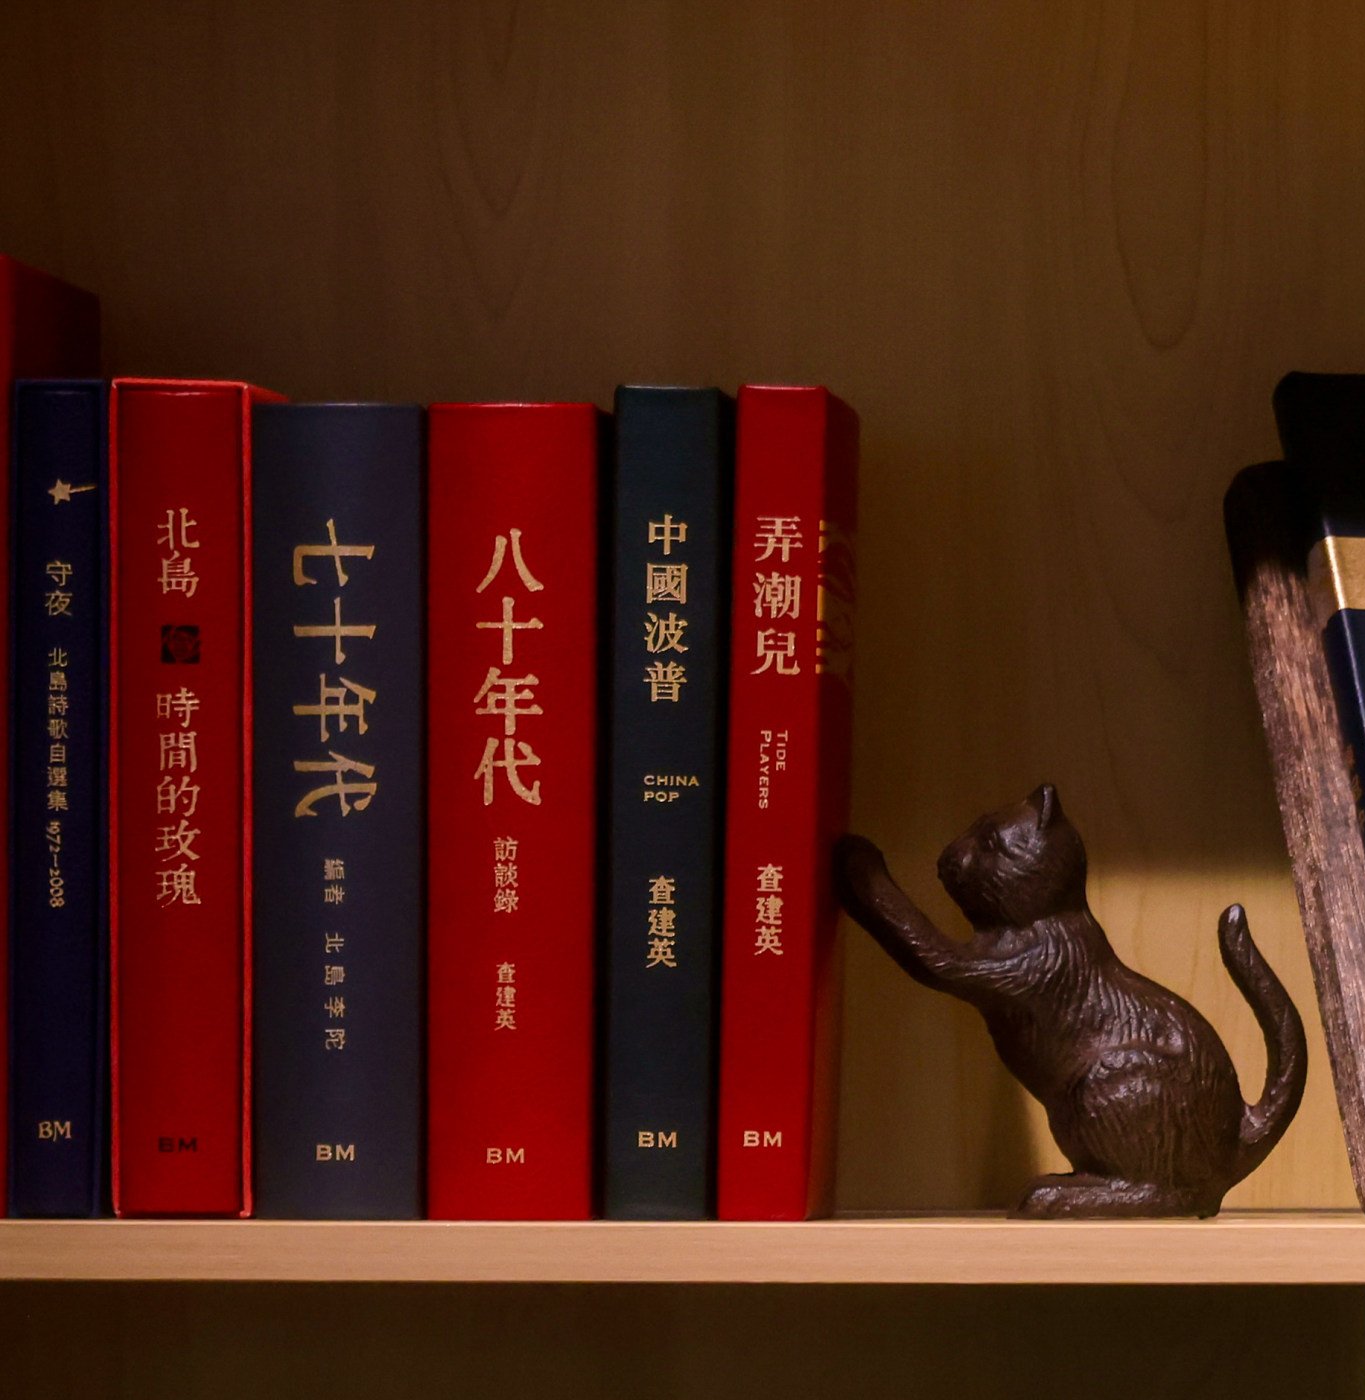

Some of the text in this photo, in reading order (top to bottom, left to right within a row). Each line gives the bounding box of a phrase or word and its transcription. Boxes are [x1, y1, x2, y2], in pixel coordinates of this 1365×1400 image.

[157, 507, 200, 598] 北島
[45, 560, 74, 616] 守夜
[643, 514, 689, 703] 中國波普
[750, 515, 803, 676] 弄潮兒
[292, 518, 378, 818] 七十年代
[473, 528, 544, 806] 八十年代
[46, 647, 70, 813] 北島詩歌自選集
[155, 687, 201, 908] 時間的玫瑰
[643, 774, 700, 788] CHINA
[643, 791, 680, 803] POP
[493, 836, 519, 913] 訪談錄
[37, 1120, 72, 1142] BM
[157, 1136, 198, 1153] BM
[315, 1143, 356, 1162] BM
[486, 1147, 525, 1164] BM
[638, 1131, 678, 1149] BM
[743, 1130, 783, 1148] BM
